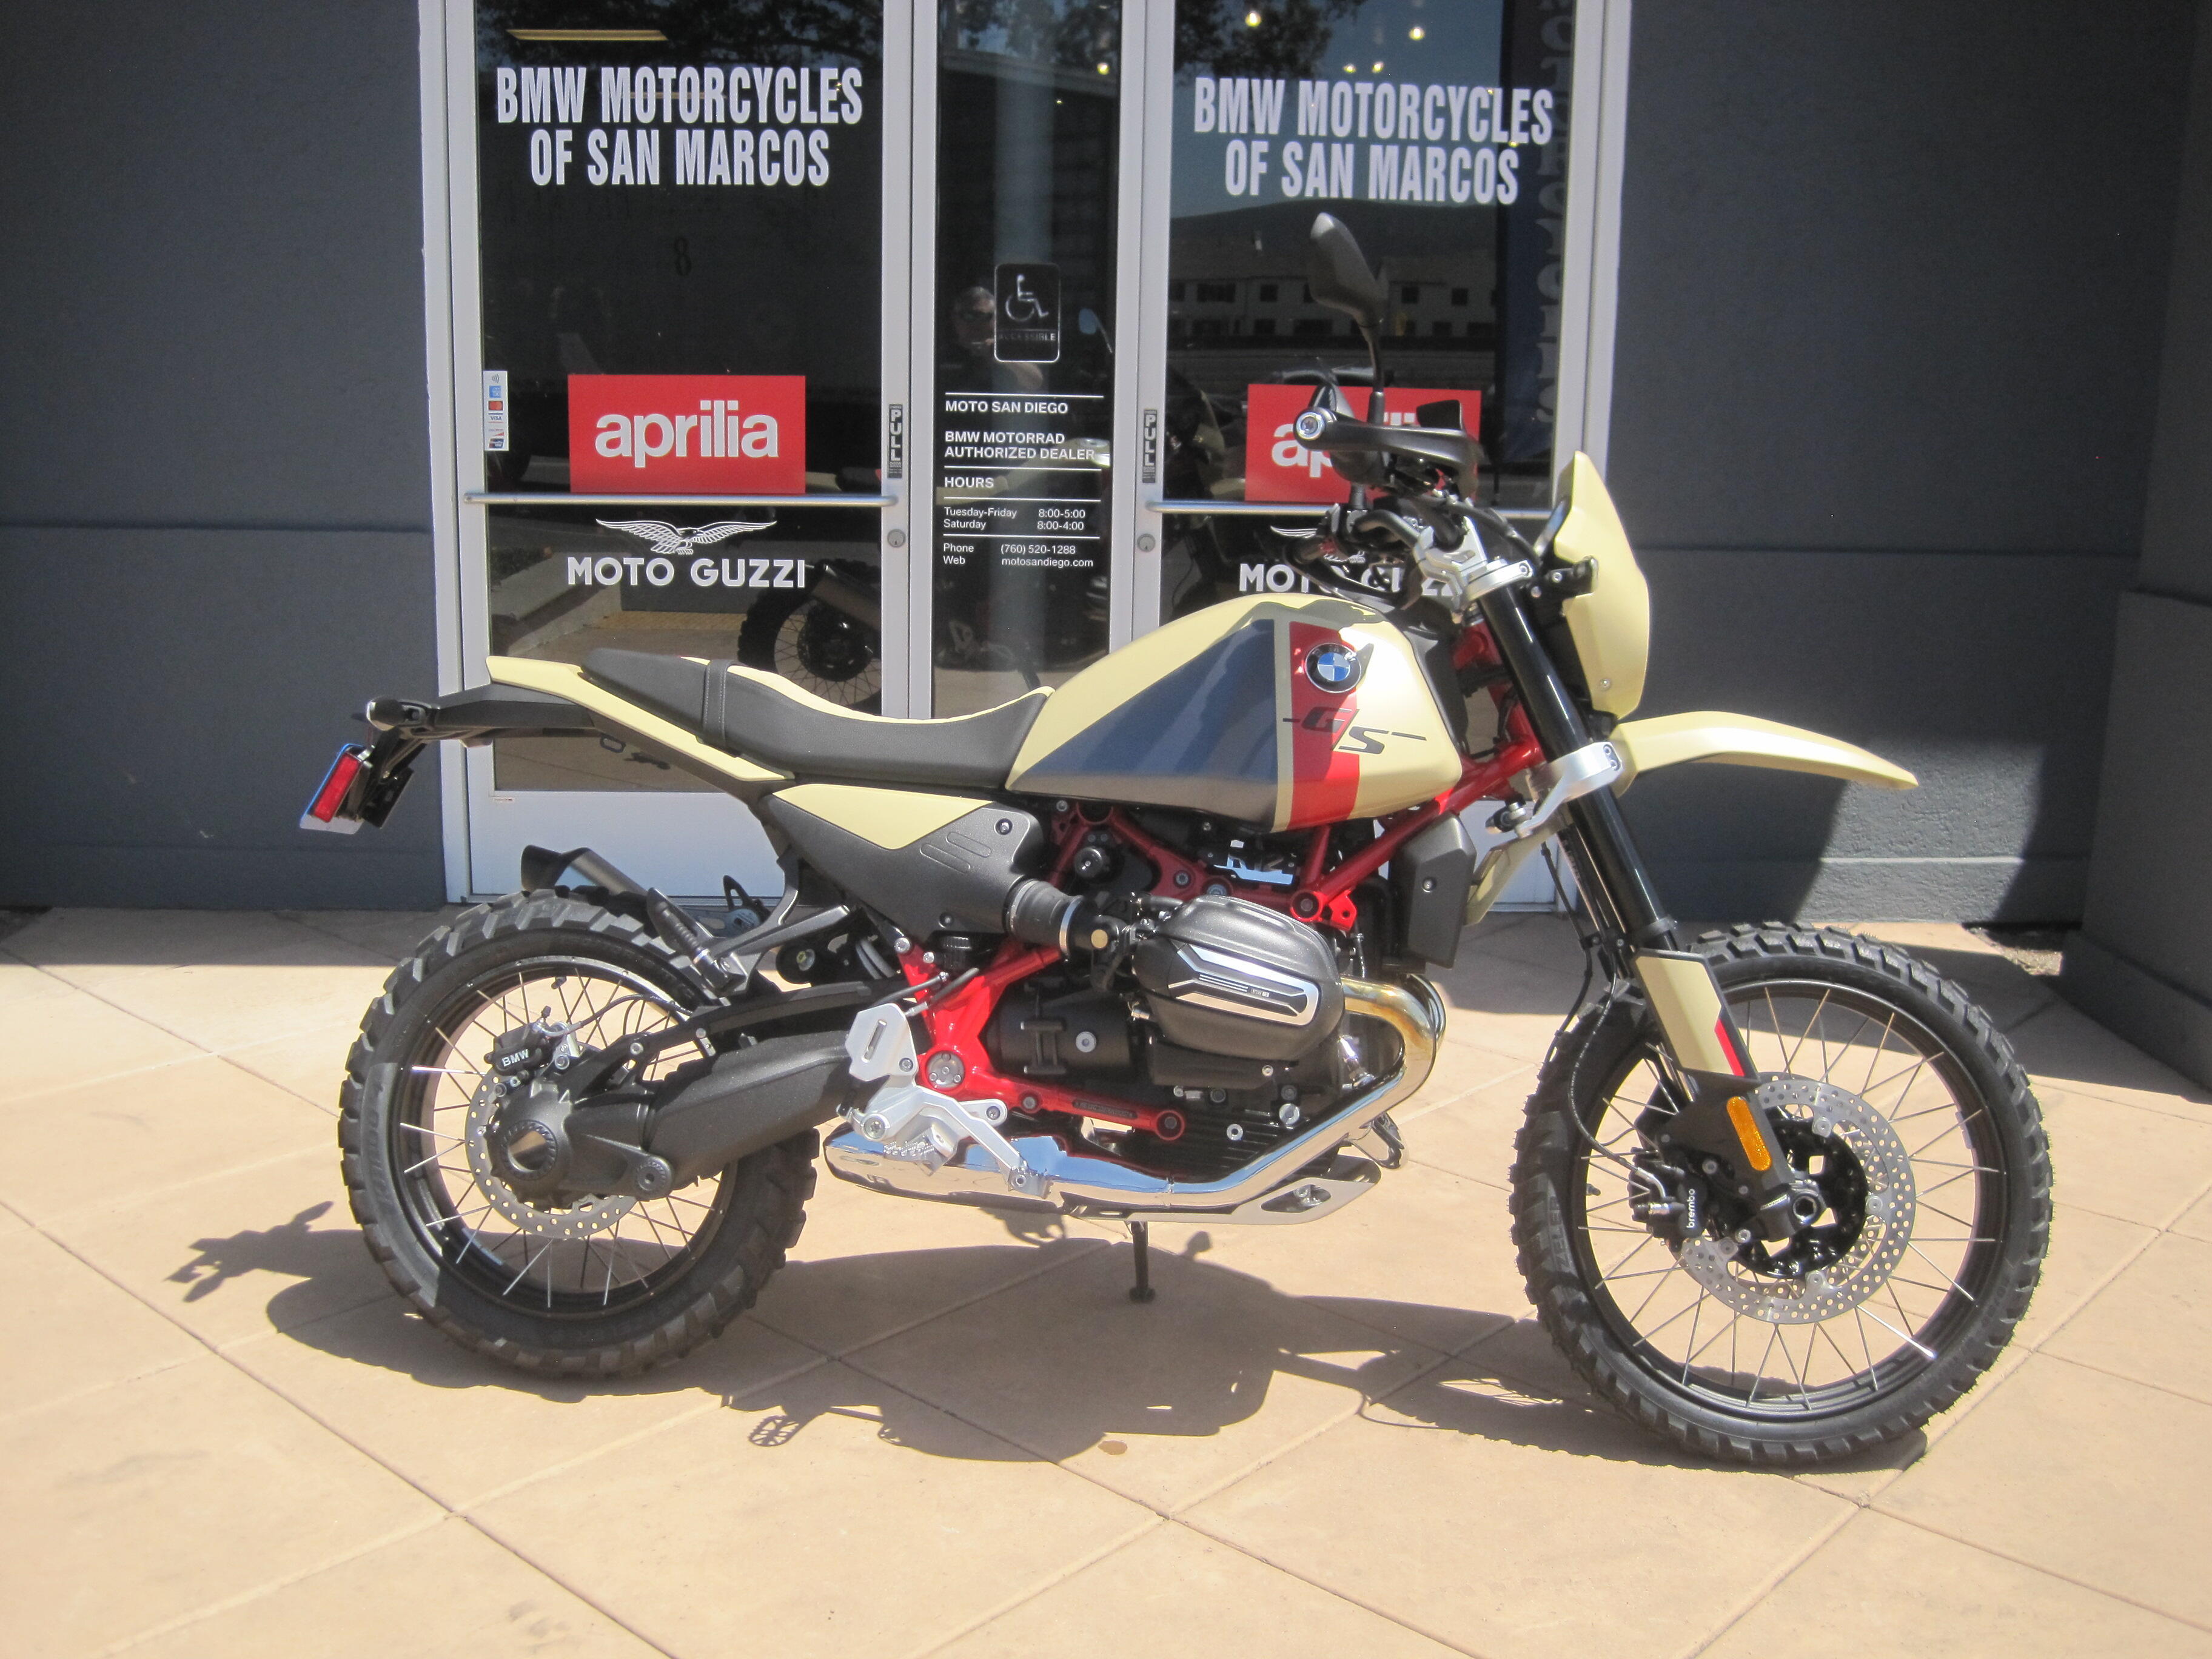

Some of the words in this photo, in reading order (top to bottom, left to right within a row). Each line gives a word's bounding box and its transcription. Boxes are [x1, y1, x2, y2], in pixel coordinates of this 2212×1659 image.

[497, 67, 586, 123] BMW
[601, 66, 863, 124] MOTORCYCLES
[1193, 77, 1285, 135] BMW
[1298, 80, 1553, 145] MOTORCYCLES
[531, 129, 572, 186] OF
[588, 129, 660, 186] SAN
[675, 129, 830, 186] MARCOS
[1225, 139, 1269, 196] OF
[1281, 141, 1354, 198] SAN
[1369, 144, 1519, 204] MARCOS
[945, 400, 988, 412] MOTO
[992, 401, 1021, 413] SAN
[1025, 402, 1068, 414] DIEGO
[595, 400, 779, 468] aprilia
[890, 409, 902, 461] PULL
[945, 431, 980, 442] BMW
[983, 432, 1065, 444] MOTORRAD
[1144, 414, 1156, 466] PULL
[945, 446, 1036, 458] AUTHORIZED
[1040, 448, 1094, 460] DEALER
[944, 477, 994, 488] HOURS
[943, 519, 987, 530] Saturday
[1037, 521, 1084, 530] 8:00-4:00
[944, 507, 1017, 518] Tuesday-Friday
[1039, 509, 1085, 518] 8:00-5:00
[943, 543, 974, 552] Phone
[1000, 544, 1025, 554] (760)
[1028, 545, 1076, 554] 520-1288
[568, 557, 674, 586] MOTO
[690, 558, 805, 588] GUZZI
[943, 555, 965, 565] Web
[1002, 557, 1093, 568] motosandiego.com
[501, 1048, 529, 1067] BMW
[1686, 1188, 1695, 1228] brembo
